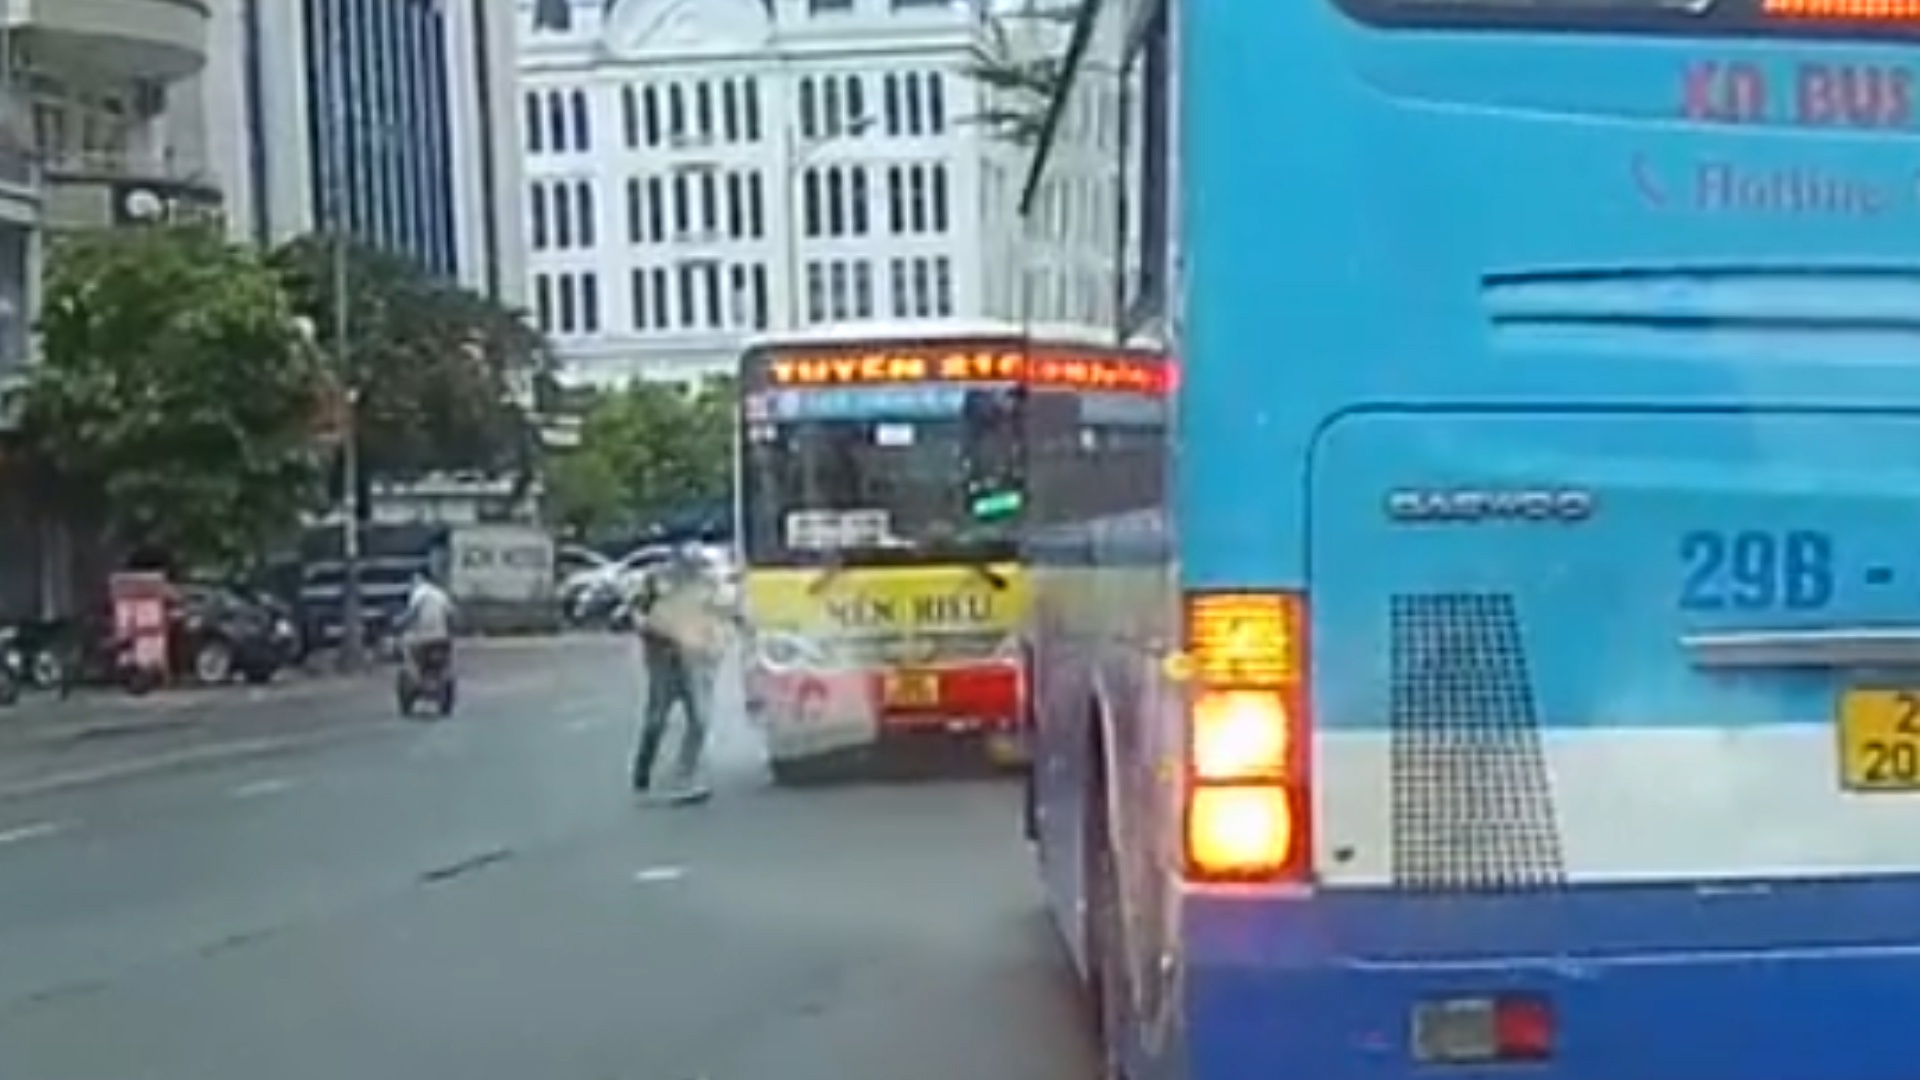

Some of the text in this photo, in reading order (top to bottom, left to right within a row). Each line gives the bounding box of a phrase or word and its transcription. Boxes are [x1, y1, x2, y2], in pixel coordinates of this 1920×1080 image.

[1797, 63, 1912, 127] BUS
[1388, 490, 1591, 520] DAEWOO
[1679, 530, 1834, 610] 29B
